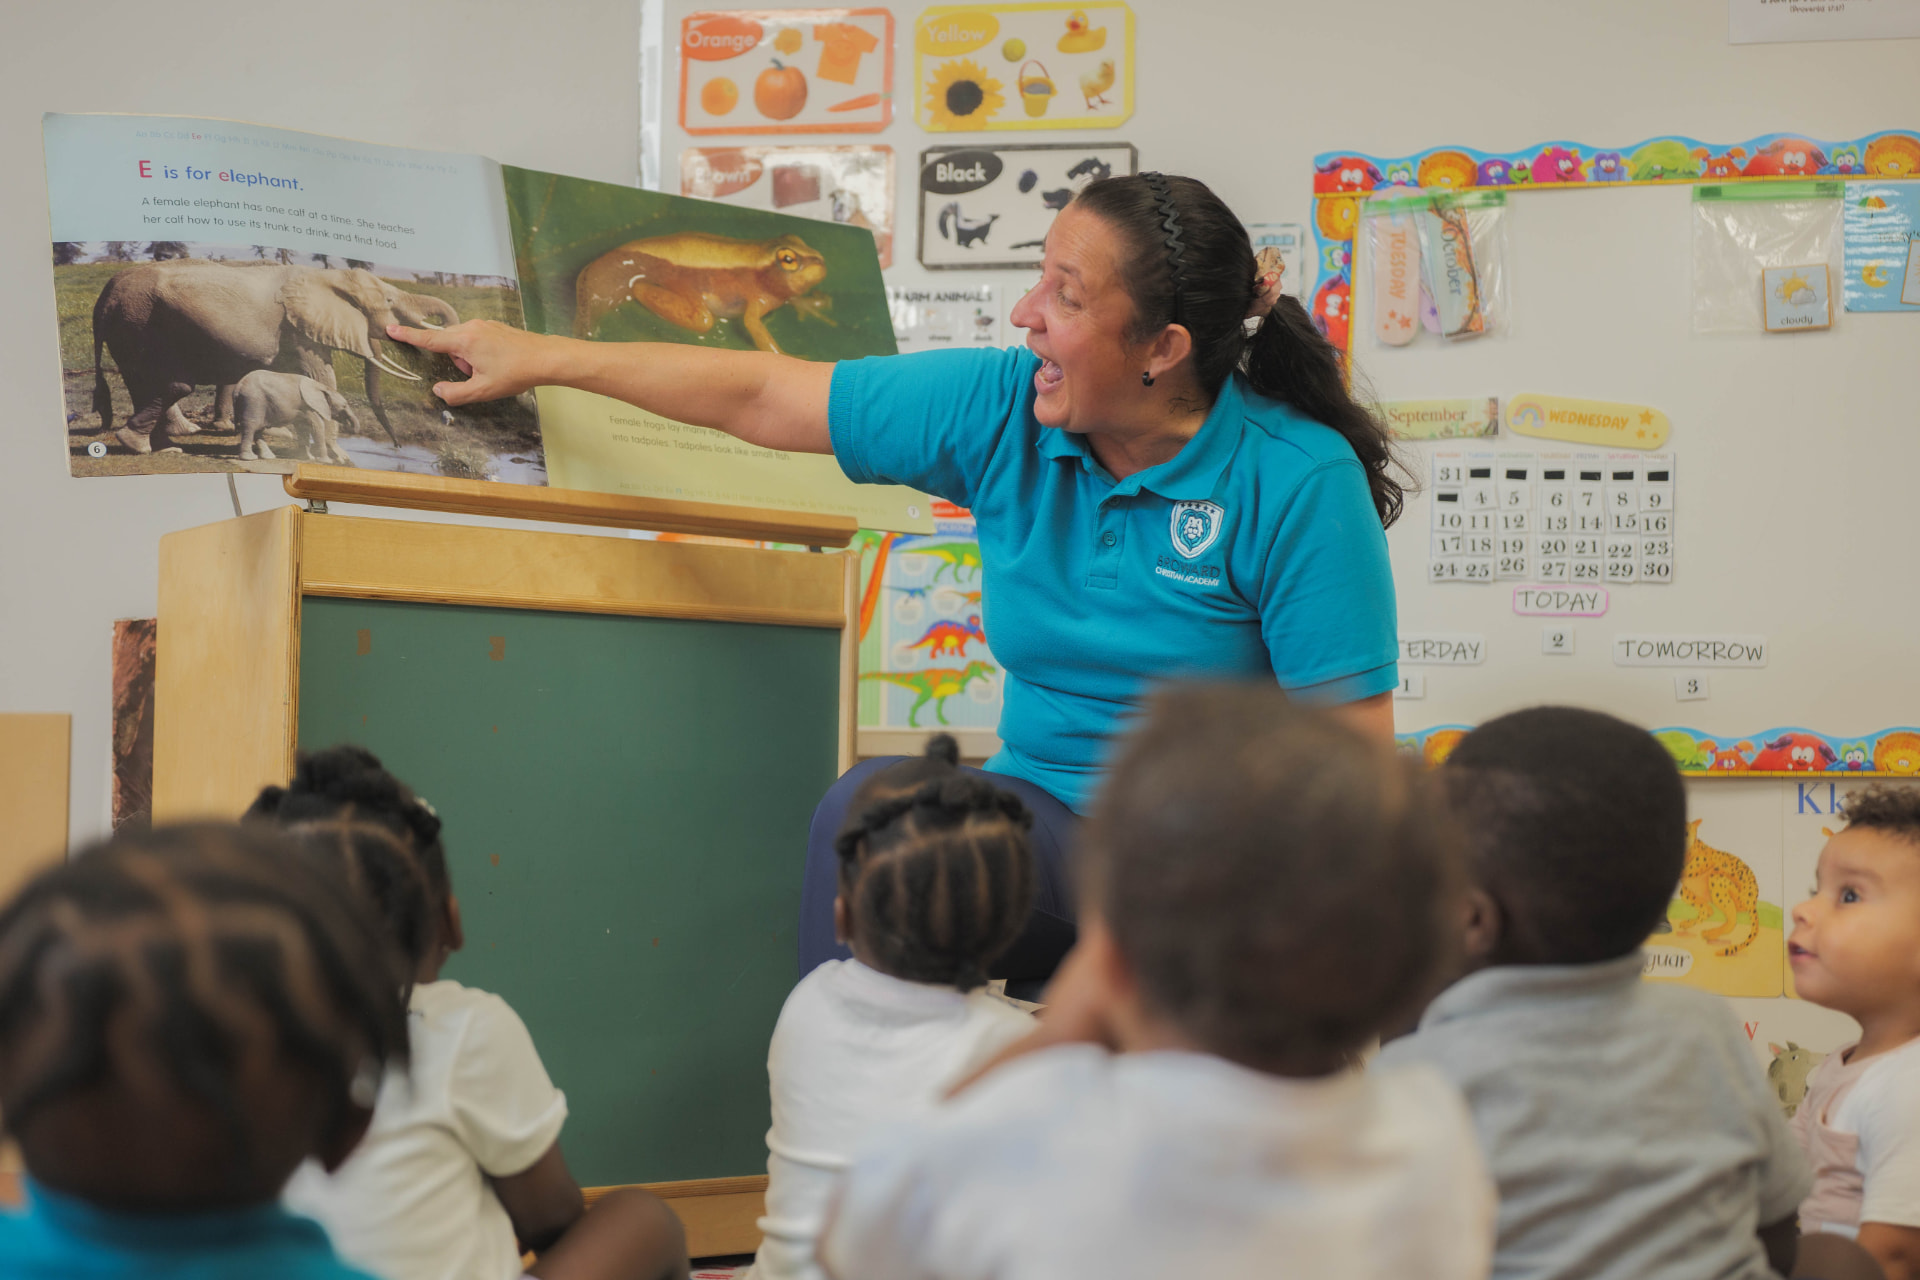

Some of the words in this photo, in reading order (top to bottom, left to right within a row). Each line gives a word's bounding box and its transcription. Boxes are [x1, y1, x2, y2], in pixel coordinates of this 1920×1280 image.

[685, 30, 756, 52] Orange
[927, 24, 986, 43] Yellow
[192, 132, 202, 140] Ee
[138, 160, 153, 178] E
[163, 165, 179, 180] is
[185, 166, 212, 180] for
[218, 168, 304, 192] elephant.
[694, 166, 750, 184] Bown
[936, 161, 987, 182] Black
[142, 197, 150, 206] A
[153, 196, 190, 206] female
[194, 198, 240, 209] elephant
[244, 201, 262, 212] has
[266, 206, 285, 214] one
[288, 208, 305, 216] calf
[330, 214, 354, 225] time.
[356, 218, 375, 229] She
[377, 222, 416, 235] teaches
[144, 214, 162, 224] her
[164, 214, 184, 224] calf
[188, 216, 210, 224] how
[214, 218, 224, 226] to
[250, 220, 261, 228] its
[264, 221, 290, 232] trunk
[292, 226, 303, 234] to
[306, 227, 330, 238] drink
[333, 232, 352, 242] and
[354, 234, 373, 246] find
[1389, 230, 1407, 300] TUESDAY
[1441, 226, 1462, 296] October
[934, 291, 992, 302] ANIMALS
[1780, 314, 1813, 326] cloudy
[609, 416, 641, 427] Female
[644, 420, 666, 432] frogs
[668, 422, 680, 434] lay
[682, 426, 706, 436] many
[1388, 408, 1468, 428] September
[1550, 410, 1629, 431] WEDNESDAY
[94, 446, 101, 454] 6
[612, 434, 629, 442] into
[672, 440, 713, 452] Tadpoles
[714, 444, 733, 454] look
[1440, 467, 1461, 481] 31
[1475, 491, 1488, 504] 4
[1508, 490, 1520, 505] 5
[1551, 492, 1563, 507] 6
[1582, 492, 1592, 506] 7
[1617, 492, 1628, 506] 8
[1649, 493, 1662, 508] 9
[1440, 514, 1462, 528] 10
[1471, 515, 1489, 528] 11
[1504, 514, 1525, 528] 12
[1547, 516, 1568, 530] 13
[1581, 516, 1602, 530] 14
[1616, 514, 1636, 528] 15
[1645, 516, 1666, 531] 16
[1442, 536, 1461, 552] 17
[1471, 537, 1491, 552] 18
[1502, 539, 1524, 554] 19
[1540, 540, 1566, 554] 20
[1575, 540, 1597, 554] 21
[1608, 544, 1632, 558] 22
[1644, 541, 1669, 556] 23
[1157, 554, 1220, 578] BROWARD
[1433, 562, 1458, 577] 24
[1466, 563, 1490, 578] 25
[1500, 558, 1525, 572] 26
[1542, 562, 1566, 576] 27
[1575, 563, 1599, 578] 28
[1608, 562, 1633, 577] 29
[1644, 562, 1670, 577] 30
[1156, 566, 1184, 582] CHRISTIAN
[1184, 575, 1220, 587] ACADEMY
[1517, 590, 1599, 612] TODAY
[1552, 633, 1564, 648] 2
[1399, 640, 1481, 662] ERDAY
[1618, 640, 1763, 662] TOMORROW
[1404, 678, 1410, 692] 1
[1687, 678, 1699, 694] 3
[1794, 781, 1846, 815] Kk
